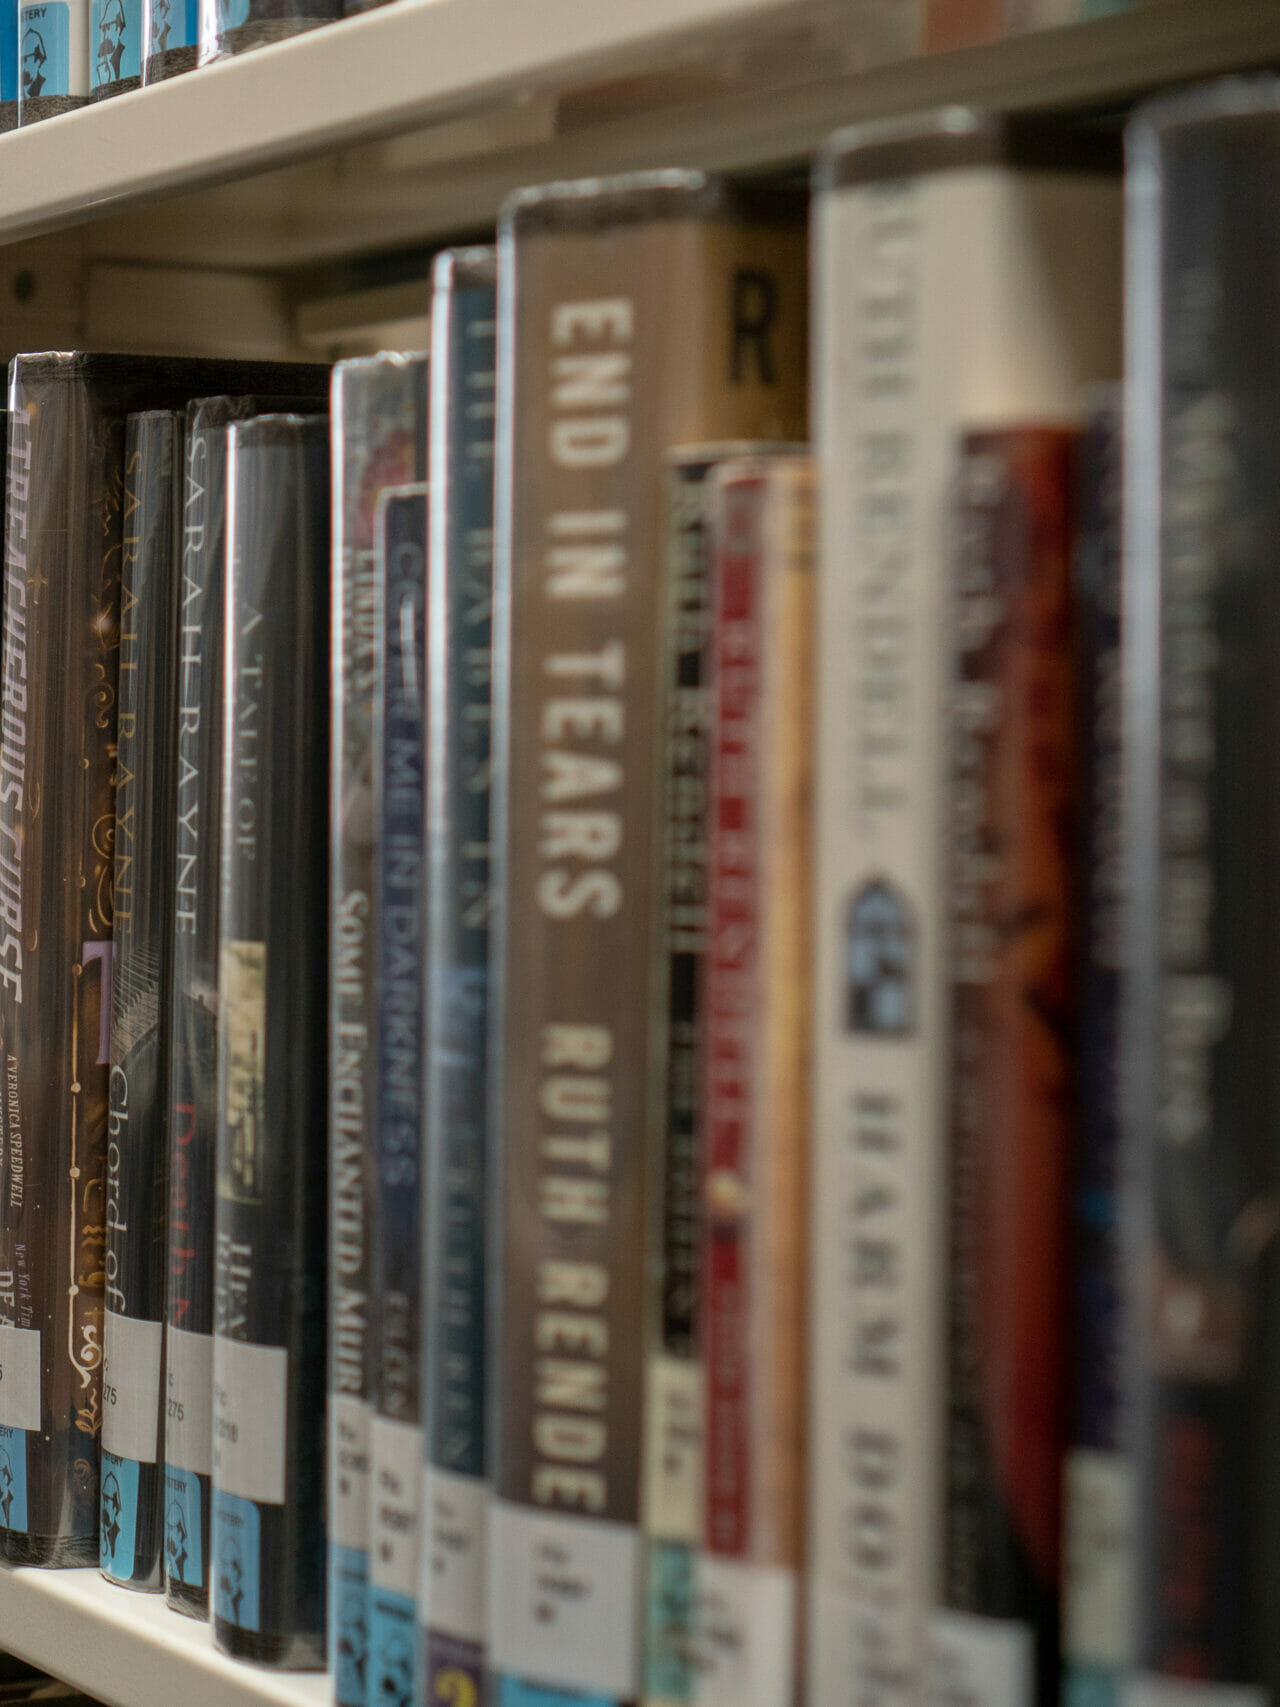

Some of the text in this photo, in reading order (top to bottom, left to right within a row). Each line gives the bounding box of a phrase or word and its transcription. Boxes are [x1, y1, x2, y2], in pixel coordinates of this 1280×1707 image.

[0, 438, 33, 812] TREACHEROUS
[114, 450, 142, 934] SARAH RAYNE
[176, 436, 208, 935] SARAH RAYNE
[537, 297, 631, 921] END IN TEARS
[7, 1066, 21, 1129] VERONICA
[9, 1132, 24, 1208] SPEEDWELL
[107, 1064, 131, 1232] Chord
[538, 1021, 616, 1225] RUTH
[104, 1249, 126, 1313] of
